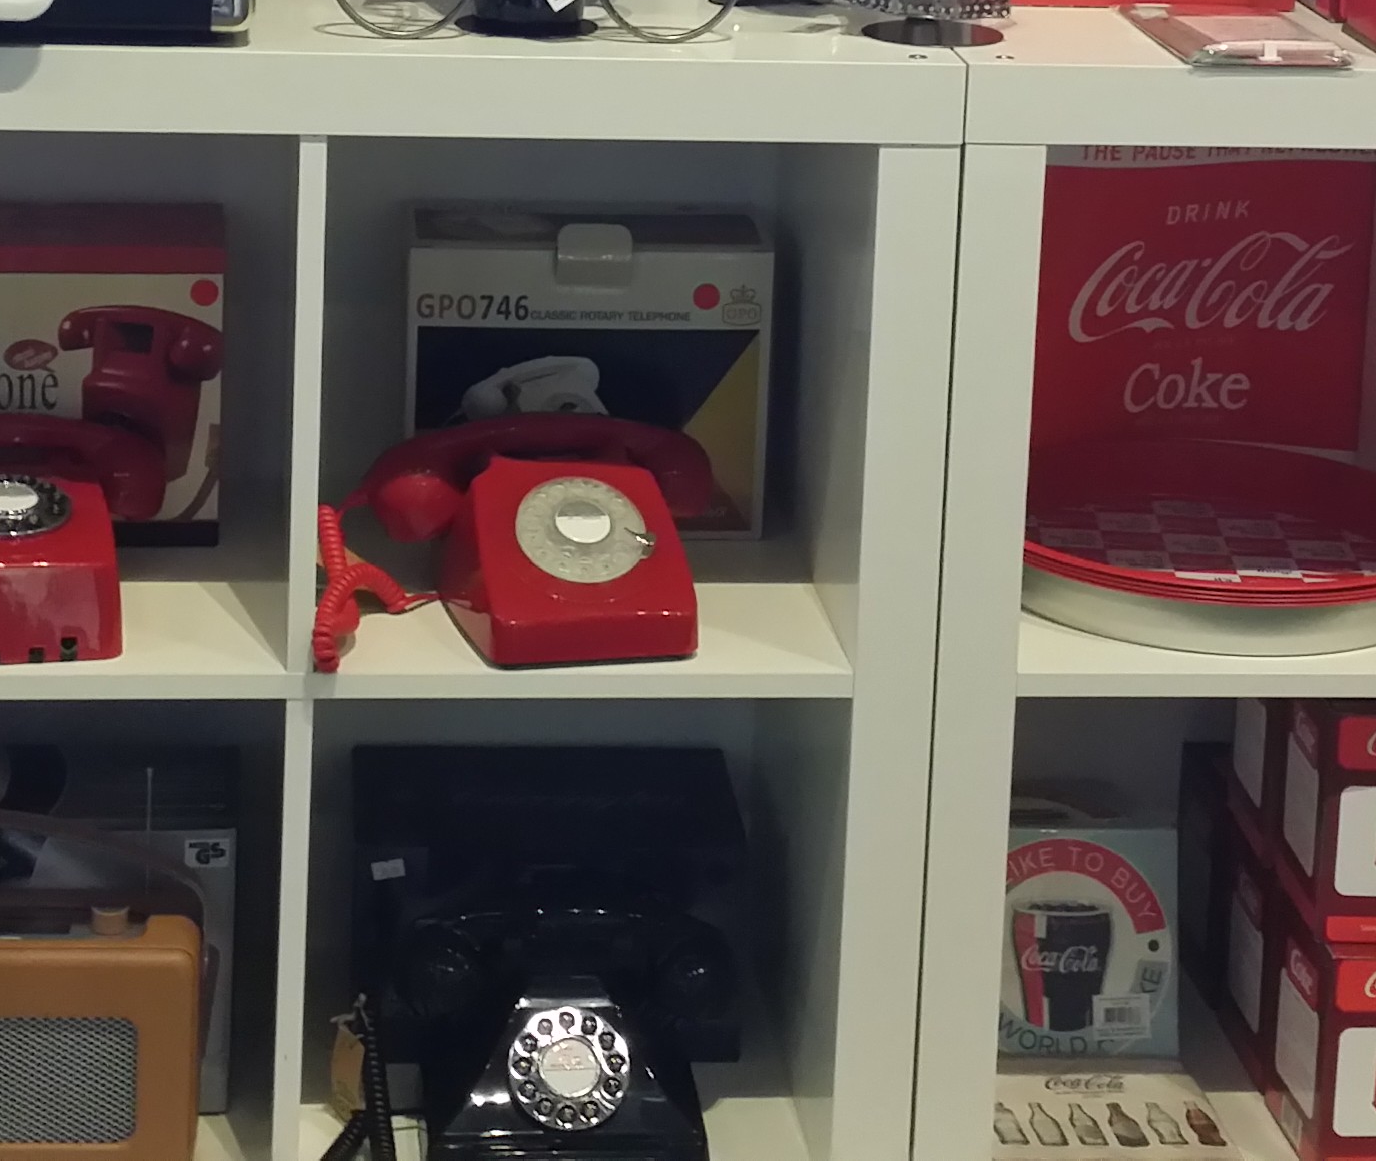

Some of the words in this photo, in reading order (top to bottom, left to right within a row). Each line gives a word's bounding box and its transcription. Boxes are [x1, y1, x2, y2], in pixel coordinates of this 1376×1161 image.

[1082, 146, 1121, 160] THE
[1166, 200, 1251, 225] DRINK
[1069, 231, 1353, 343] Coca-Cola
[530, 310, 576, 323] CLASSIC
[580, 310, 624, 323] ROTARY
[627, 310, 691, 323] TELEPHONE
[726, 305, 759, 320] GPO
[1125, 358, 1250, 413] Coke
[1068, 846, 1104, 872] TO
[1111, 867, 1157, 919] BUY
[1021, 944, 1101, 974] Coca-Cola
[1002, 1019, 1087, 1055] WORLD
